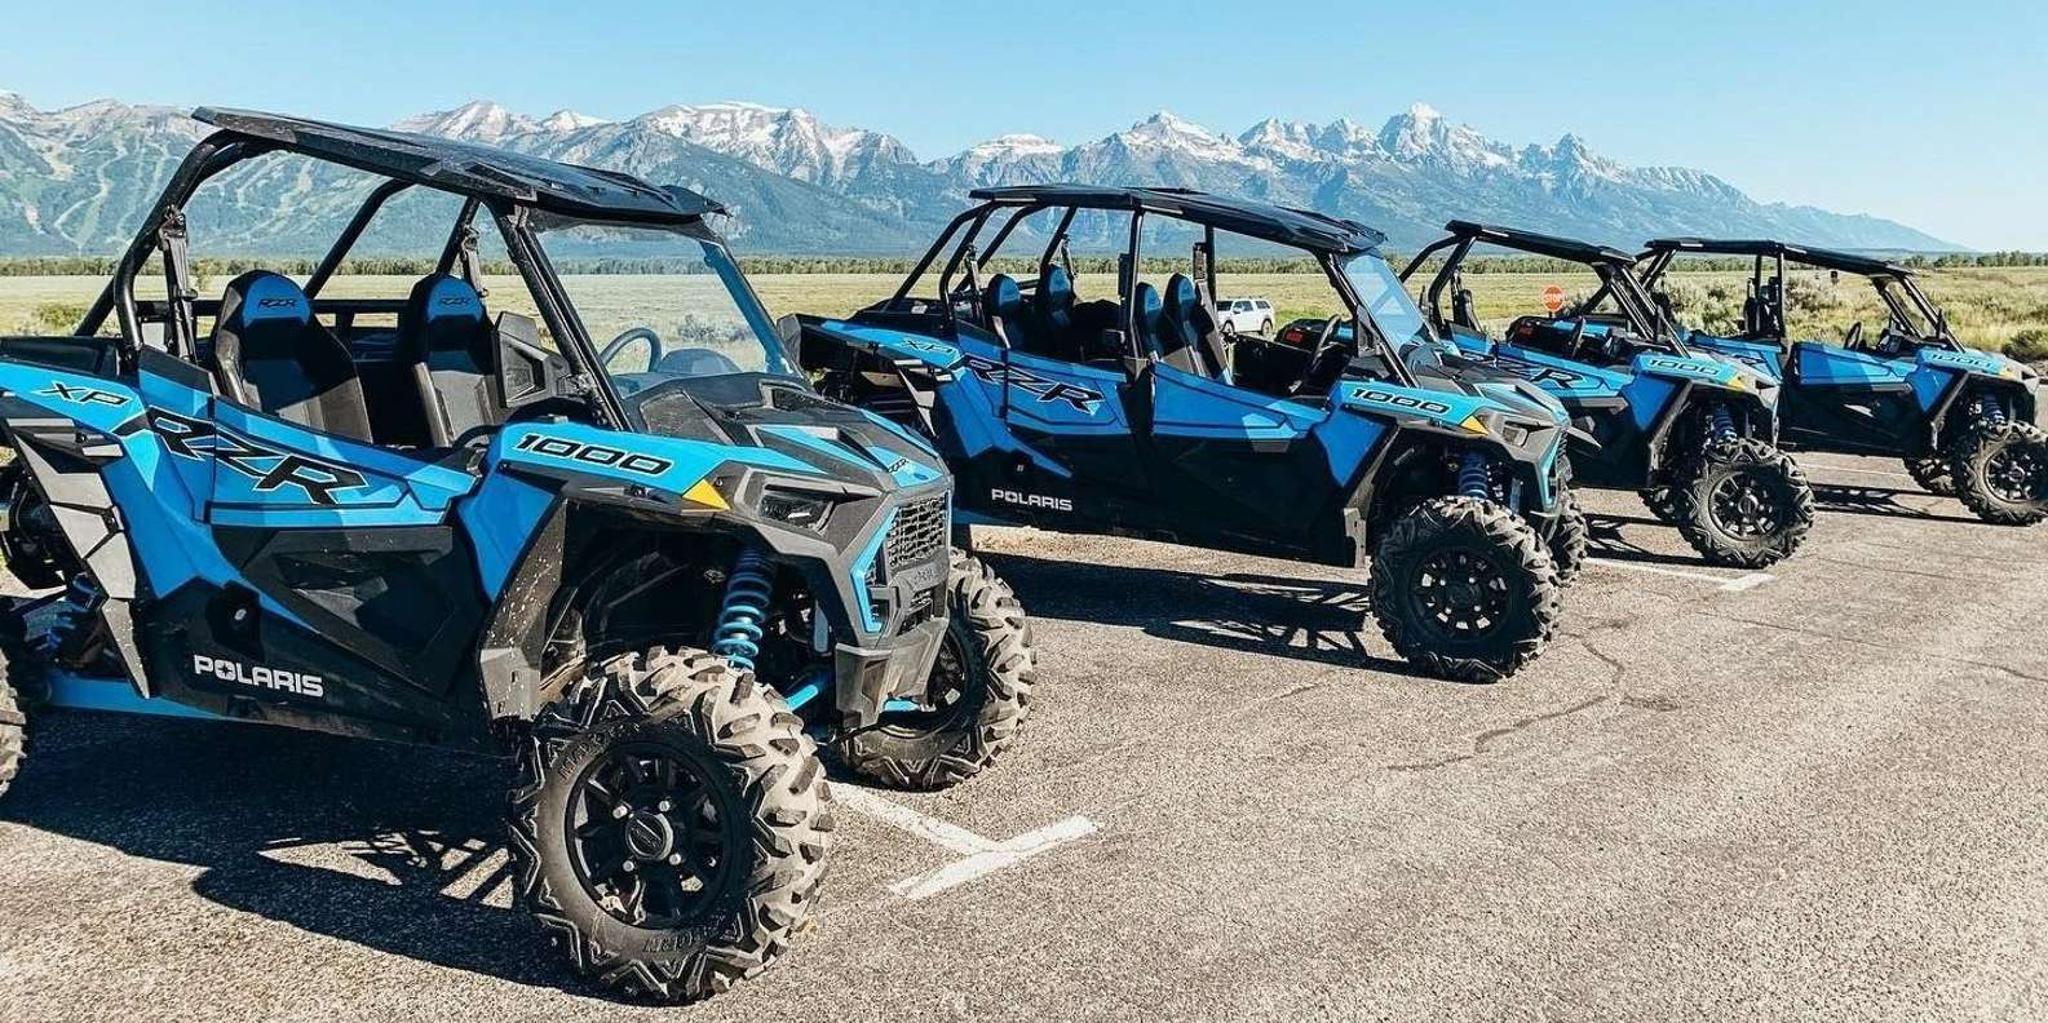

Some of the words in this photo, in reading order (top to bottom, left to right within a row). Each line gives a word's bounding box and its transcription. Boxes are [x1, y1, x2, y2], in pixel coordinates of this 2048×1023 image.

[944, 353, 1104, 416] RZR
[1649, 360, 1719, 375] 1000
[39, 382, 130, 407] XP
[1351, 388, 1451, 414] 1000
[112, 406, 369, 506] RZR
[513, 433, 674, 477] 1000
[992, 488, 1073, 511] POLARIS
[194, 655, 324, 697] POLARIS
